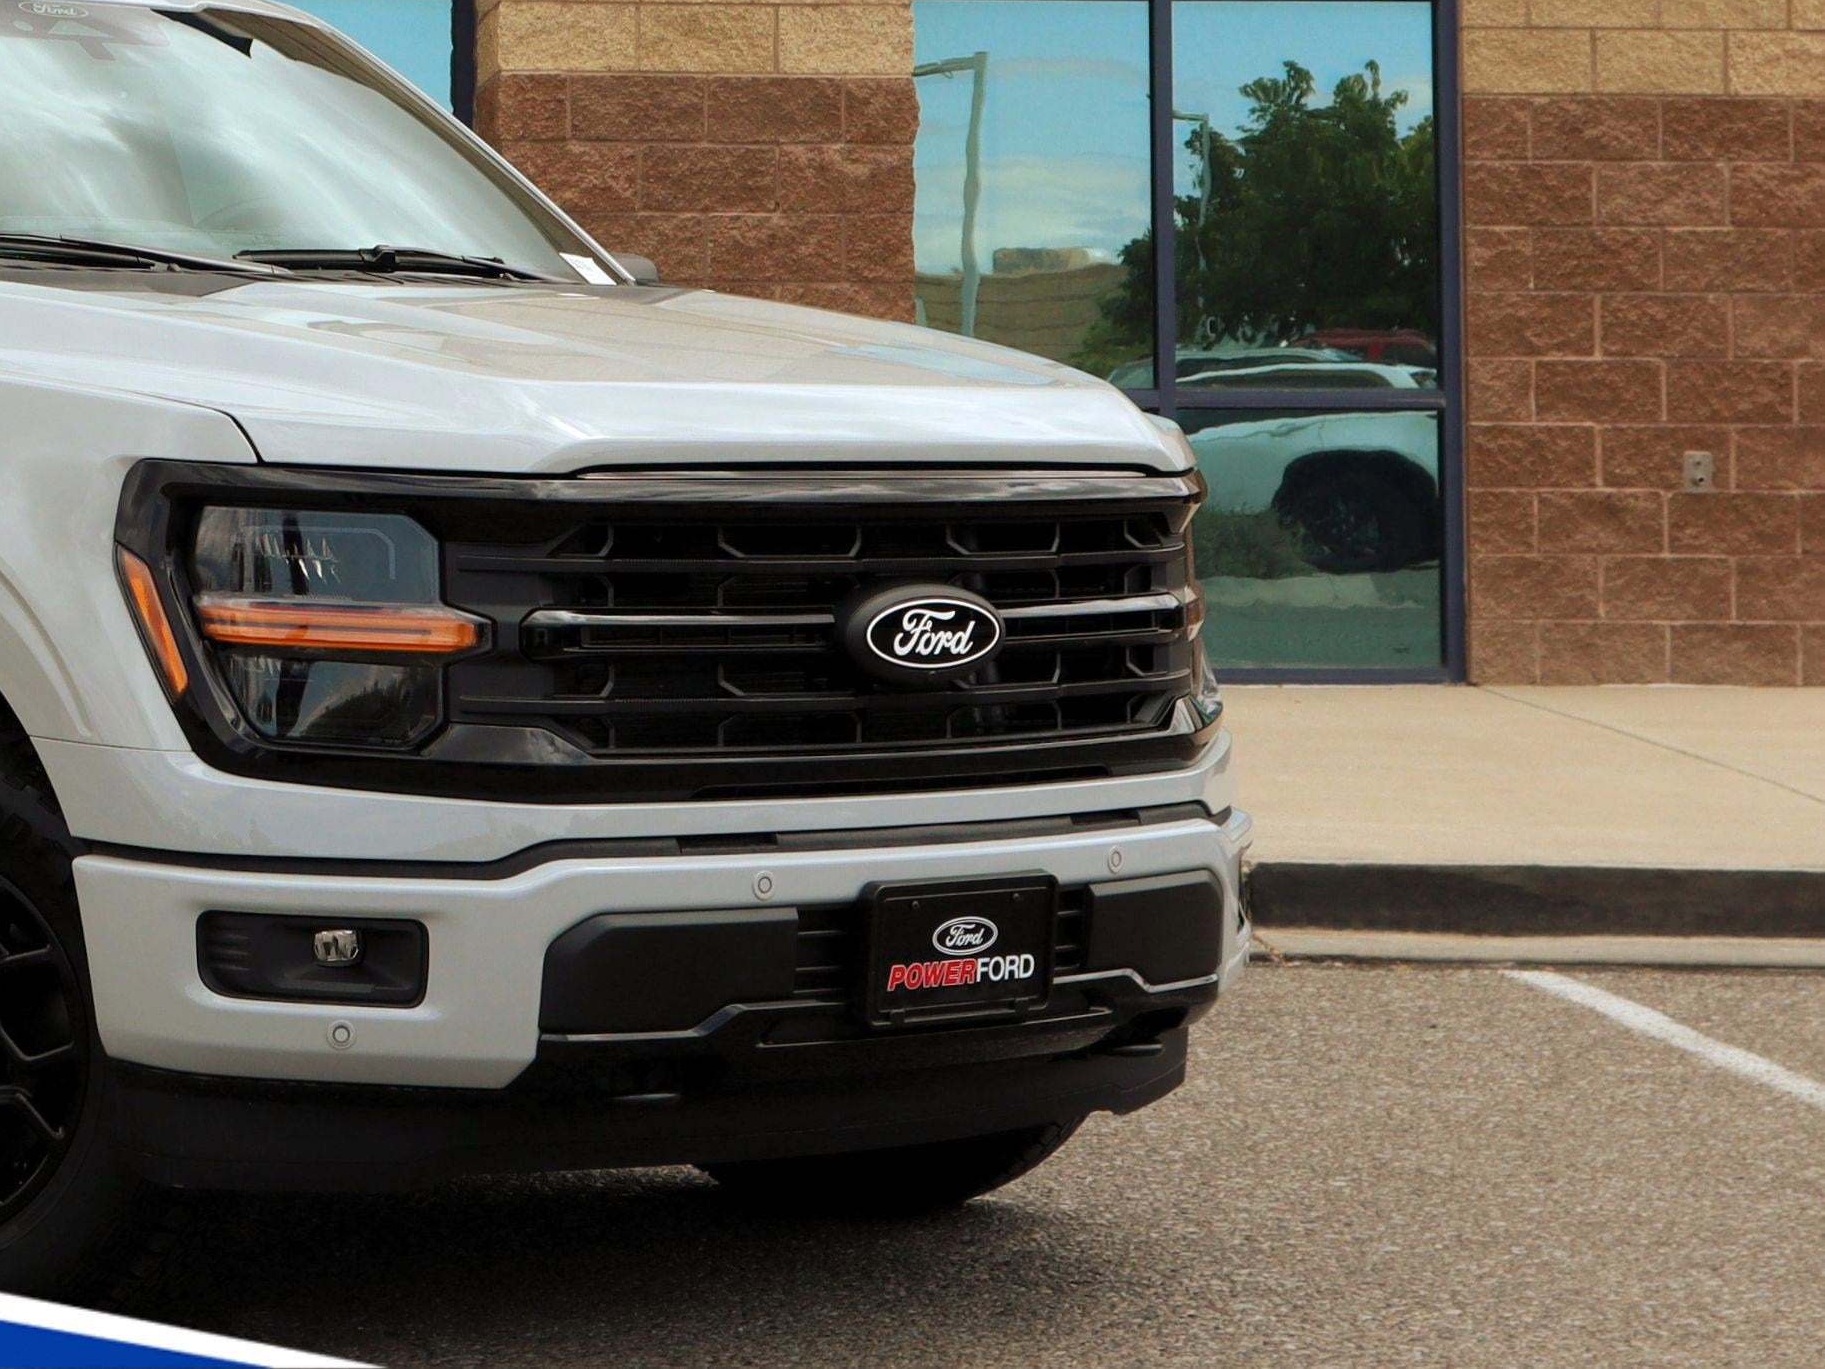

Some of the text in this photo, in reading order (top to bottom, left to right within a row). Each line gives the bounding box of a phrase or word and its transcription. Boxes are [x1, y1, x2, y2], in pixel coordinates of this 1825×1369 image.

[33, 2, 78, 16] Ford
[893, 608, 974, 657] Ford
[945, 923, 986, 948] Ford
